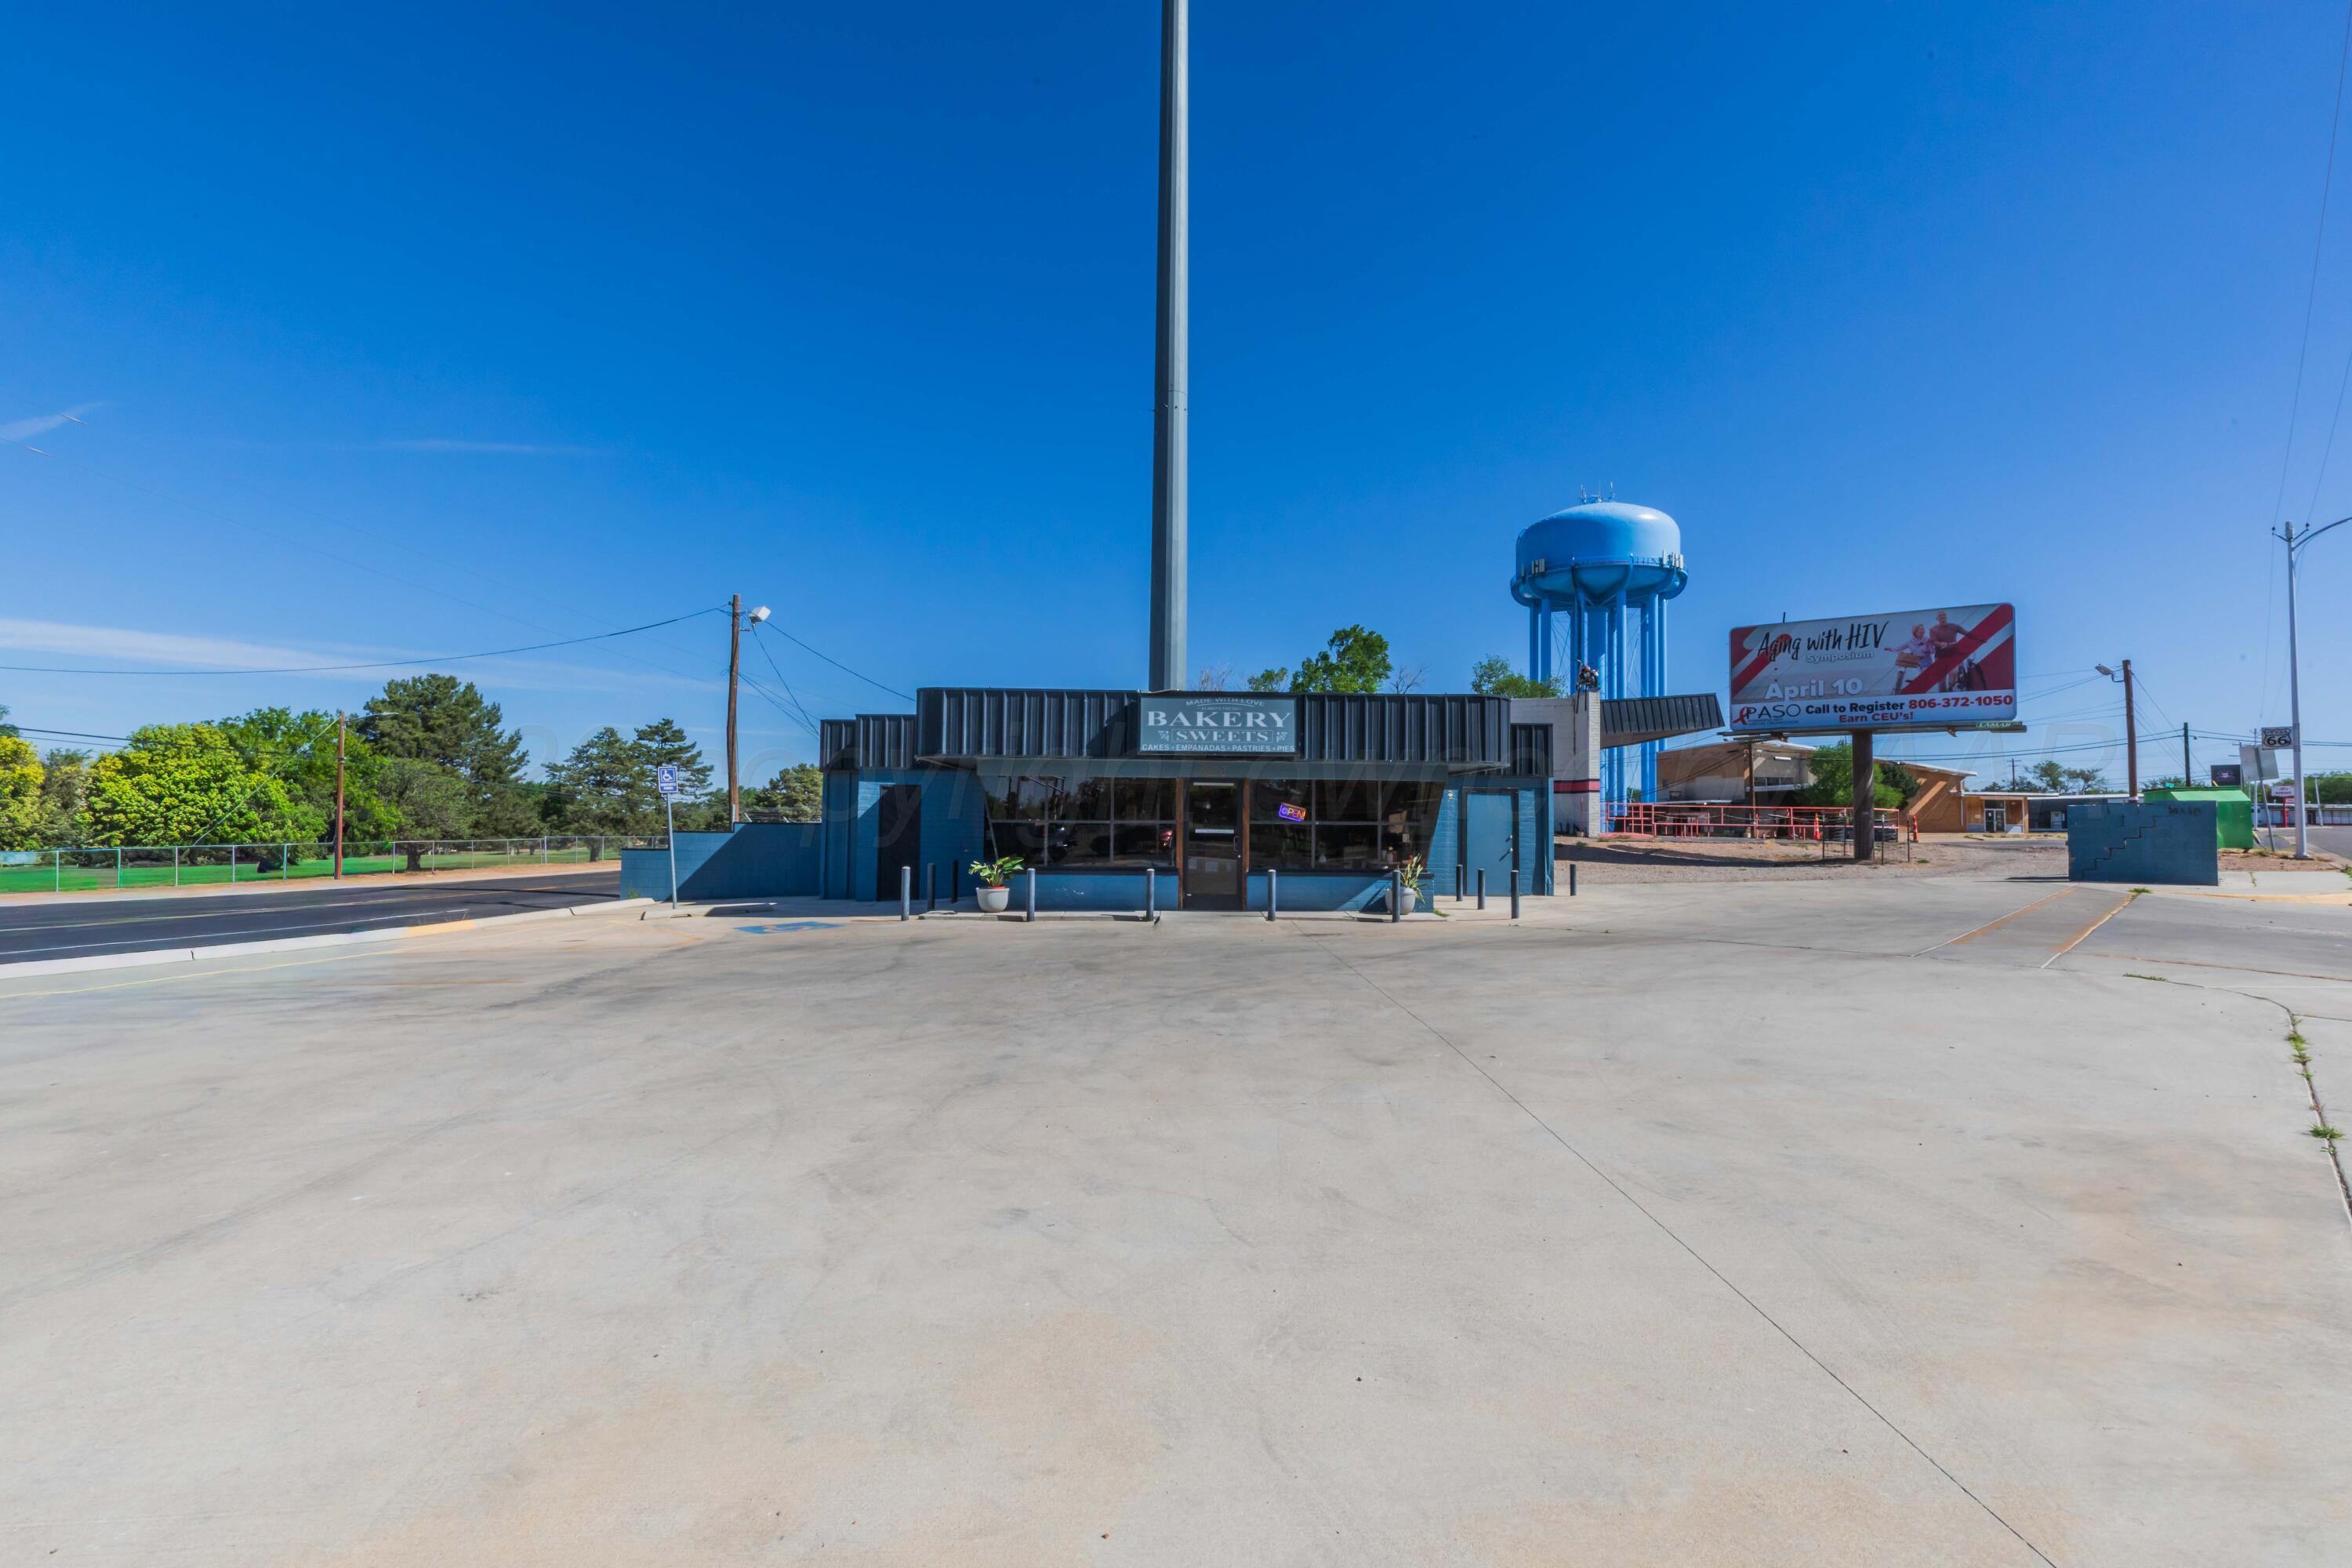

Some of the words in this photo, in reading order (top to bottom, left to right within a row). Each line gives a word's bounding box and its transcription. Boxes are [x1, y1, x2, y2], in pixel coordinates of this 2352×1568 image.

[1757, 632, 1802, 662] Aging
[1806, 630, 1842, 653] with
[1845, 621, 1889, 652] HIV
[1806, 652, 1874, 663] Symposium
[1764, 679, 1824, 703] April
[1831, 677, 1864, 696] 10
[1241, 698, 1265, 707] LOVE
[1806, 704, 1831, 715] Call
[1833, 704, 1846, 715] to
[1849, 701, 1904, 716] Register
[1908, 695, 2013, 710] 806-372-1050
[1746, 703, 1802, 720] PASO
[1838, 713, 1871, 724] Earn
[1871, 711, 1915, 723] CEU's!
[1147, 710, 1291, 728] BAKERY
[1175, 730, 1269, 742] SWEETS
[2267, 736, 2287, 746] 66
[1281, 807, 1305, 820] OPEN
